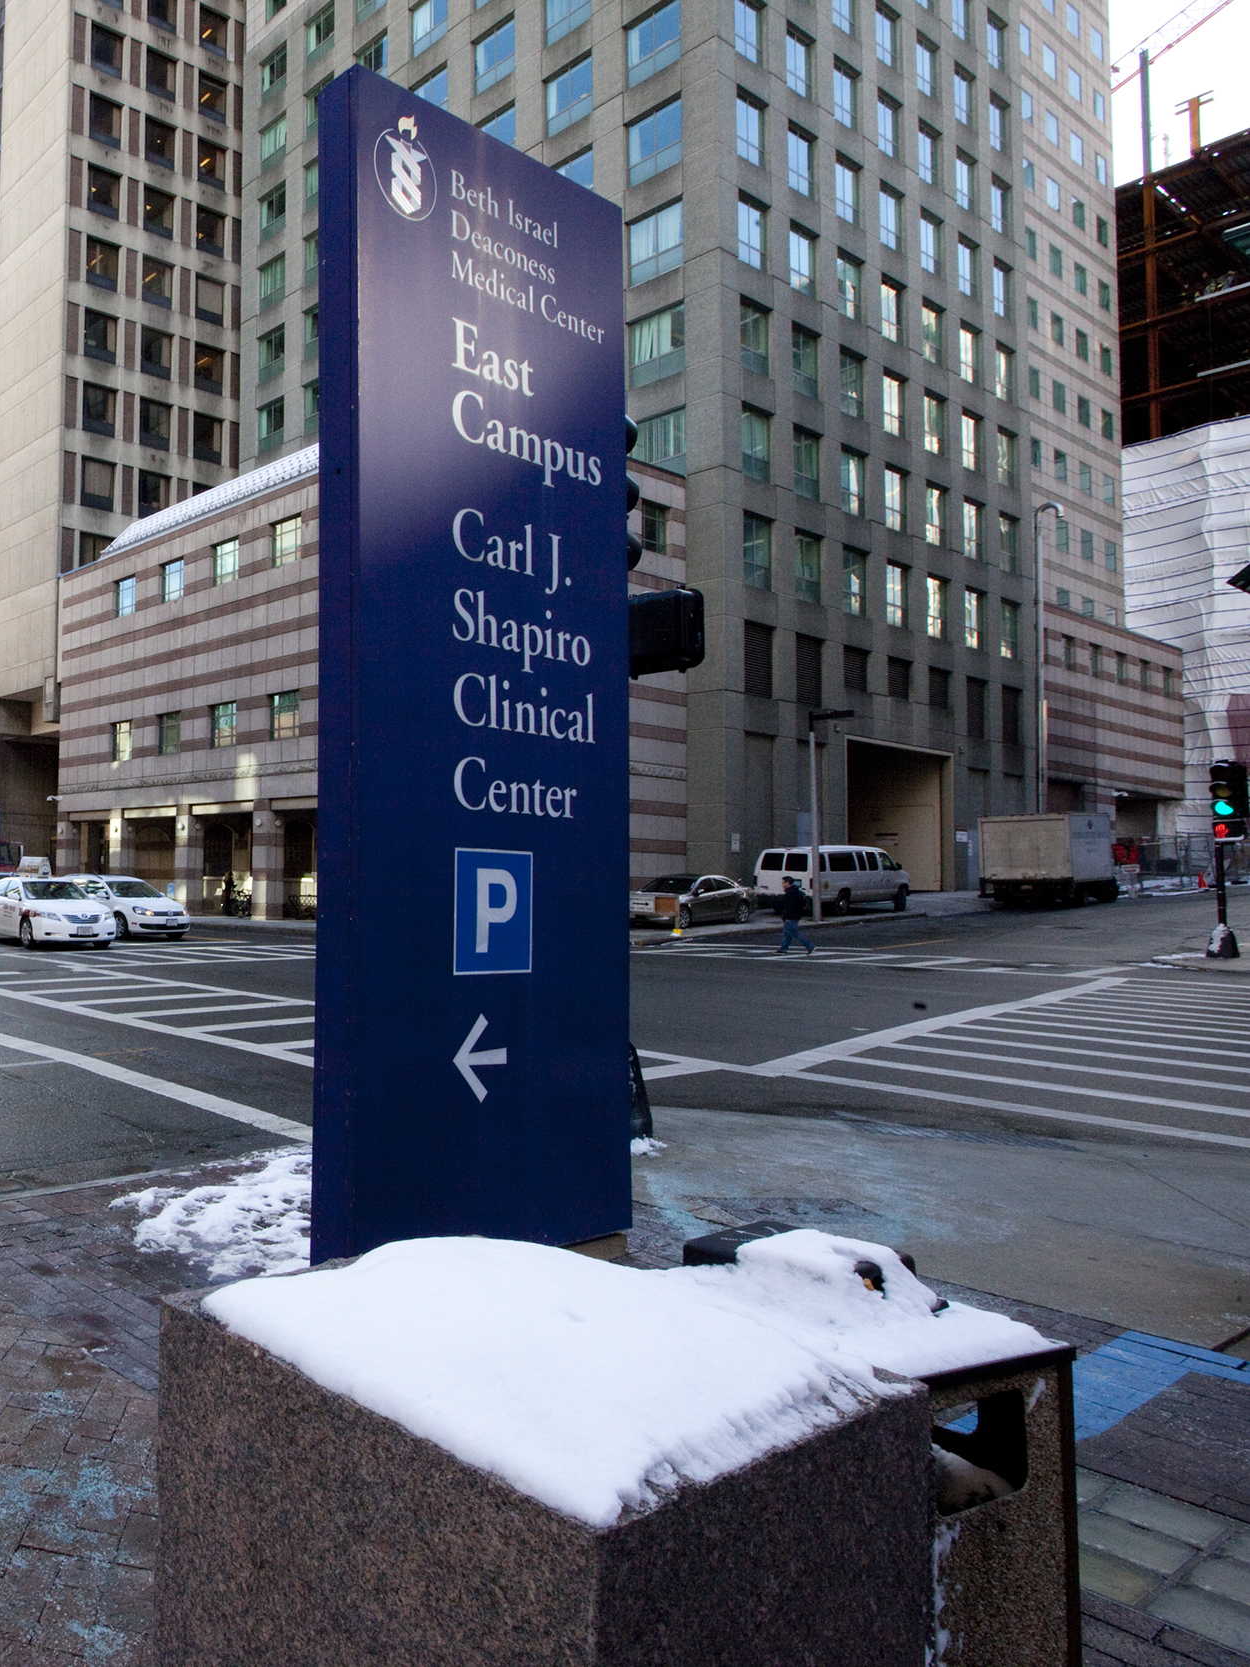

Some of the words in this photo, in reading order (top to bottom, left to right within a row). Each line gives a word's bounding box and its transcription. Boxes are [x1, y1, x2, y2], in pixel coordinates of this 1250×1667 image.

[451, 168, 500, 218] Beth
[507, 199, 559, 249] Israel
[451, 209, 557, 286] Deaconess
[451, 250, 535, 315] Medical
[540, 294, 606, 345] Center
[451, 316, 535, 397] East
[452, 389, 604, 488] Campus
[452, 507, 535, 577] Carl
[544, 532, 573, 596] J.
[452, 587, 592, 675] Shapiro
[453, 672, 597, 746] Clinical
[453, 755, 578, 819] Center
[475, 867, 518, 954] P
